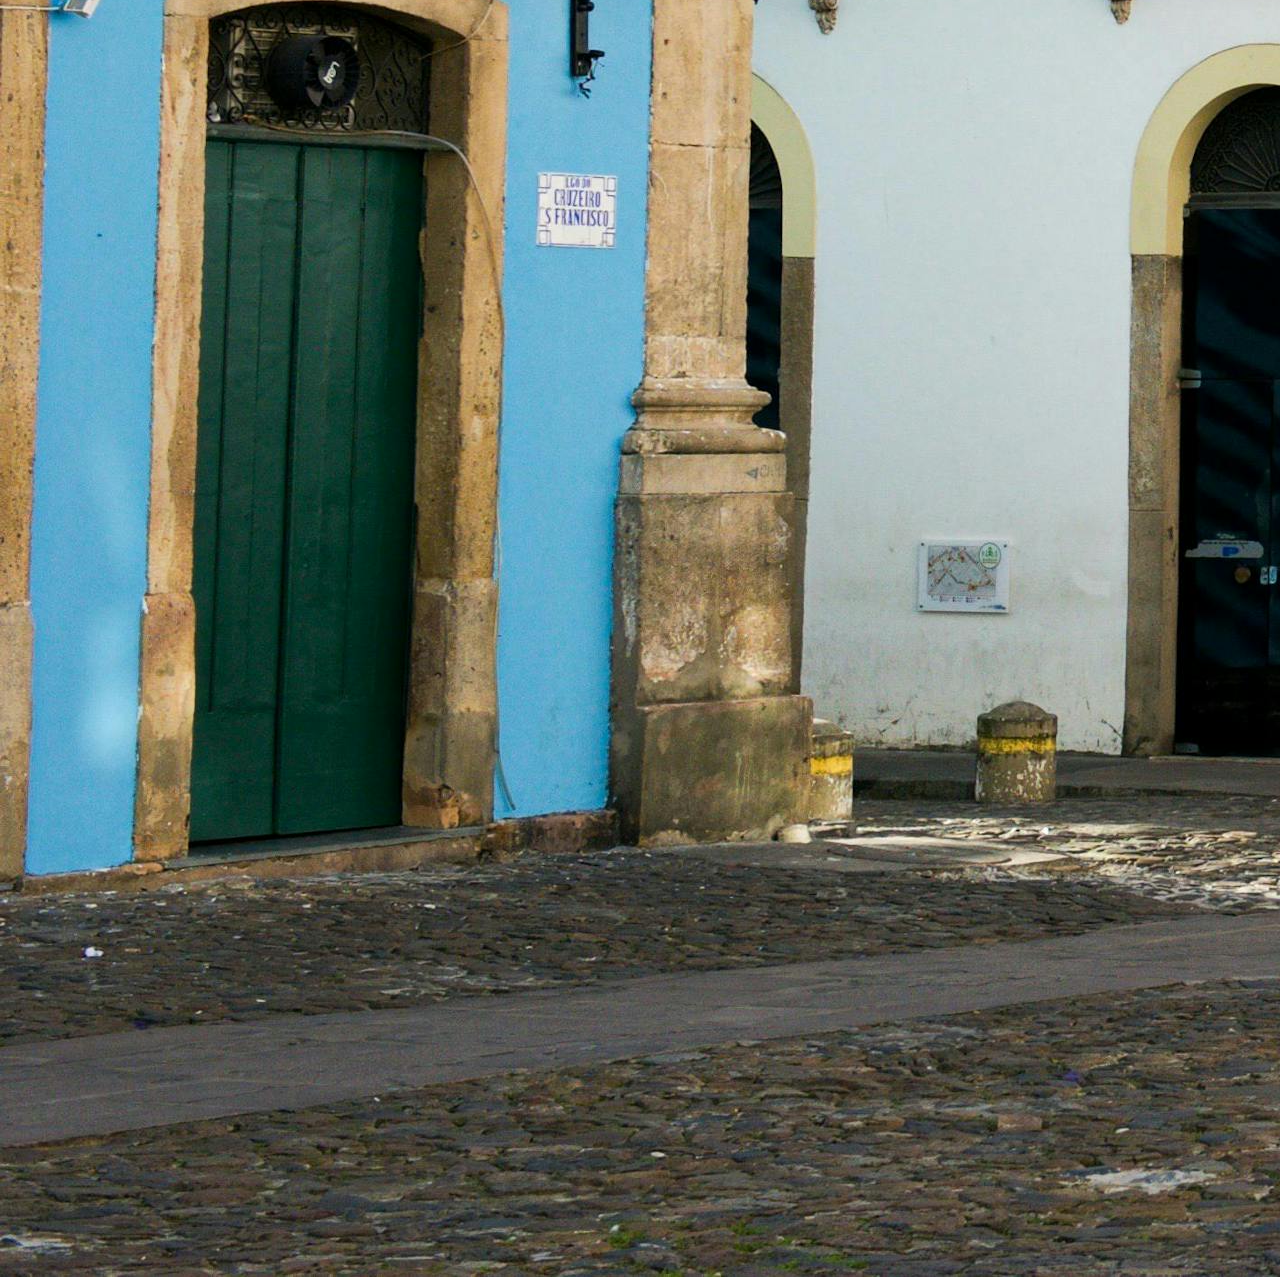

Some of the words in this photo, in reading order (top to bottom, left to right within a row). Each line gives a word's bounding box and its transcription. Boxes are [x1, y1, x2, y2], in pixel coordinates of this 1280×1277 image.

[582, 178, 591, 188] DO
[554, 188, 601, 208] CRUZEIRO
[545, 208, 551, 224] S
[555, 208, 609, 227] FRANCISCO
